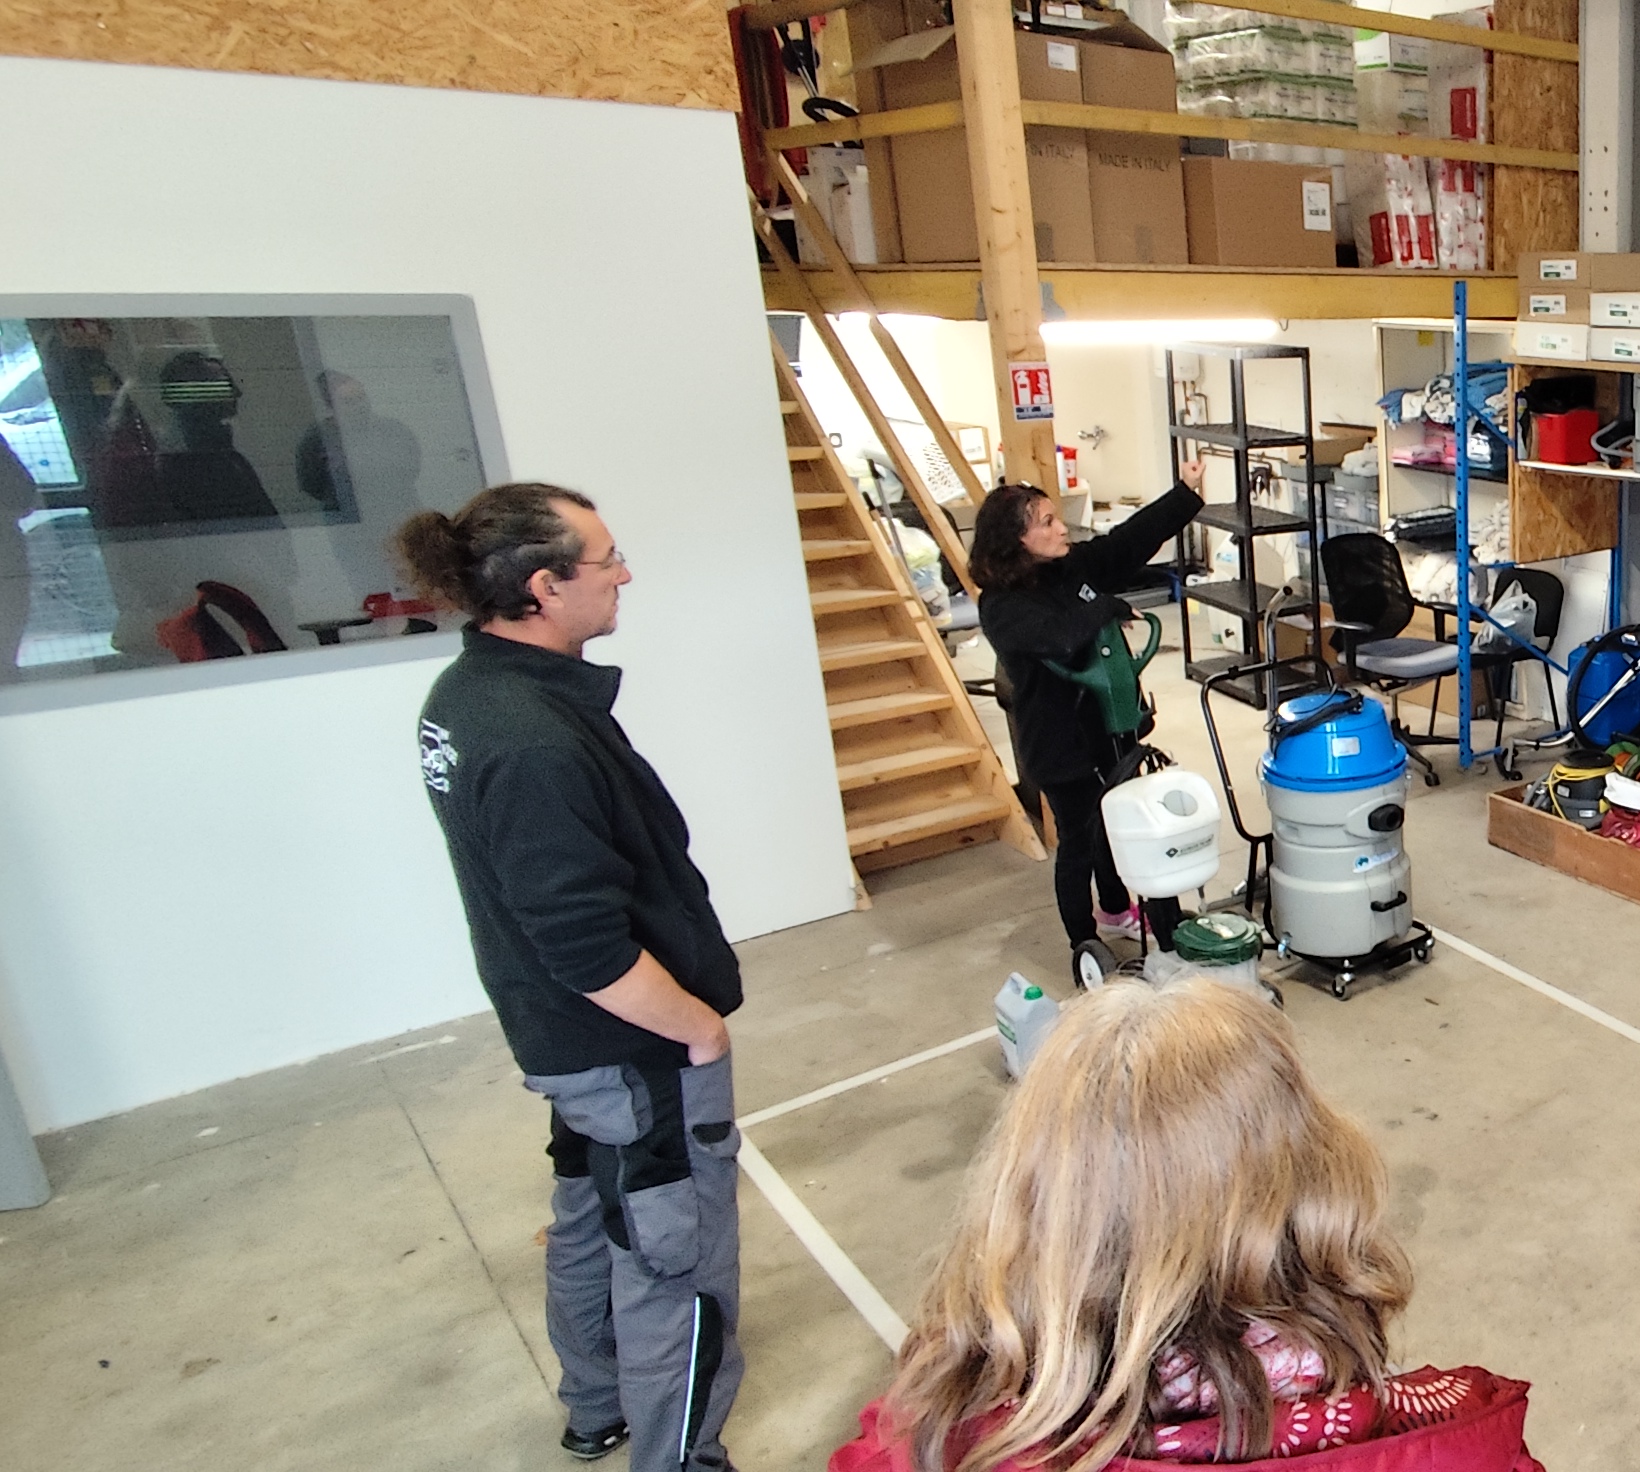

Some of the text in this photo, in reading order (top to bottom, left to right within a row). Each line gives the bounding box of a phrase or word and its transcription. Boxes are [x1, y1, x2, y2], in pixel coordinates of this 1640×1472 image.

[1045, 144, 1074, 159] ITALY
[1098, 152, 1171, 172] MADE IN ITALY
